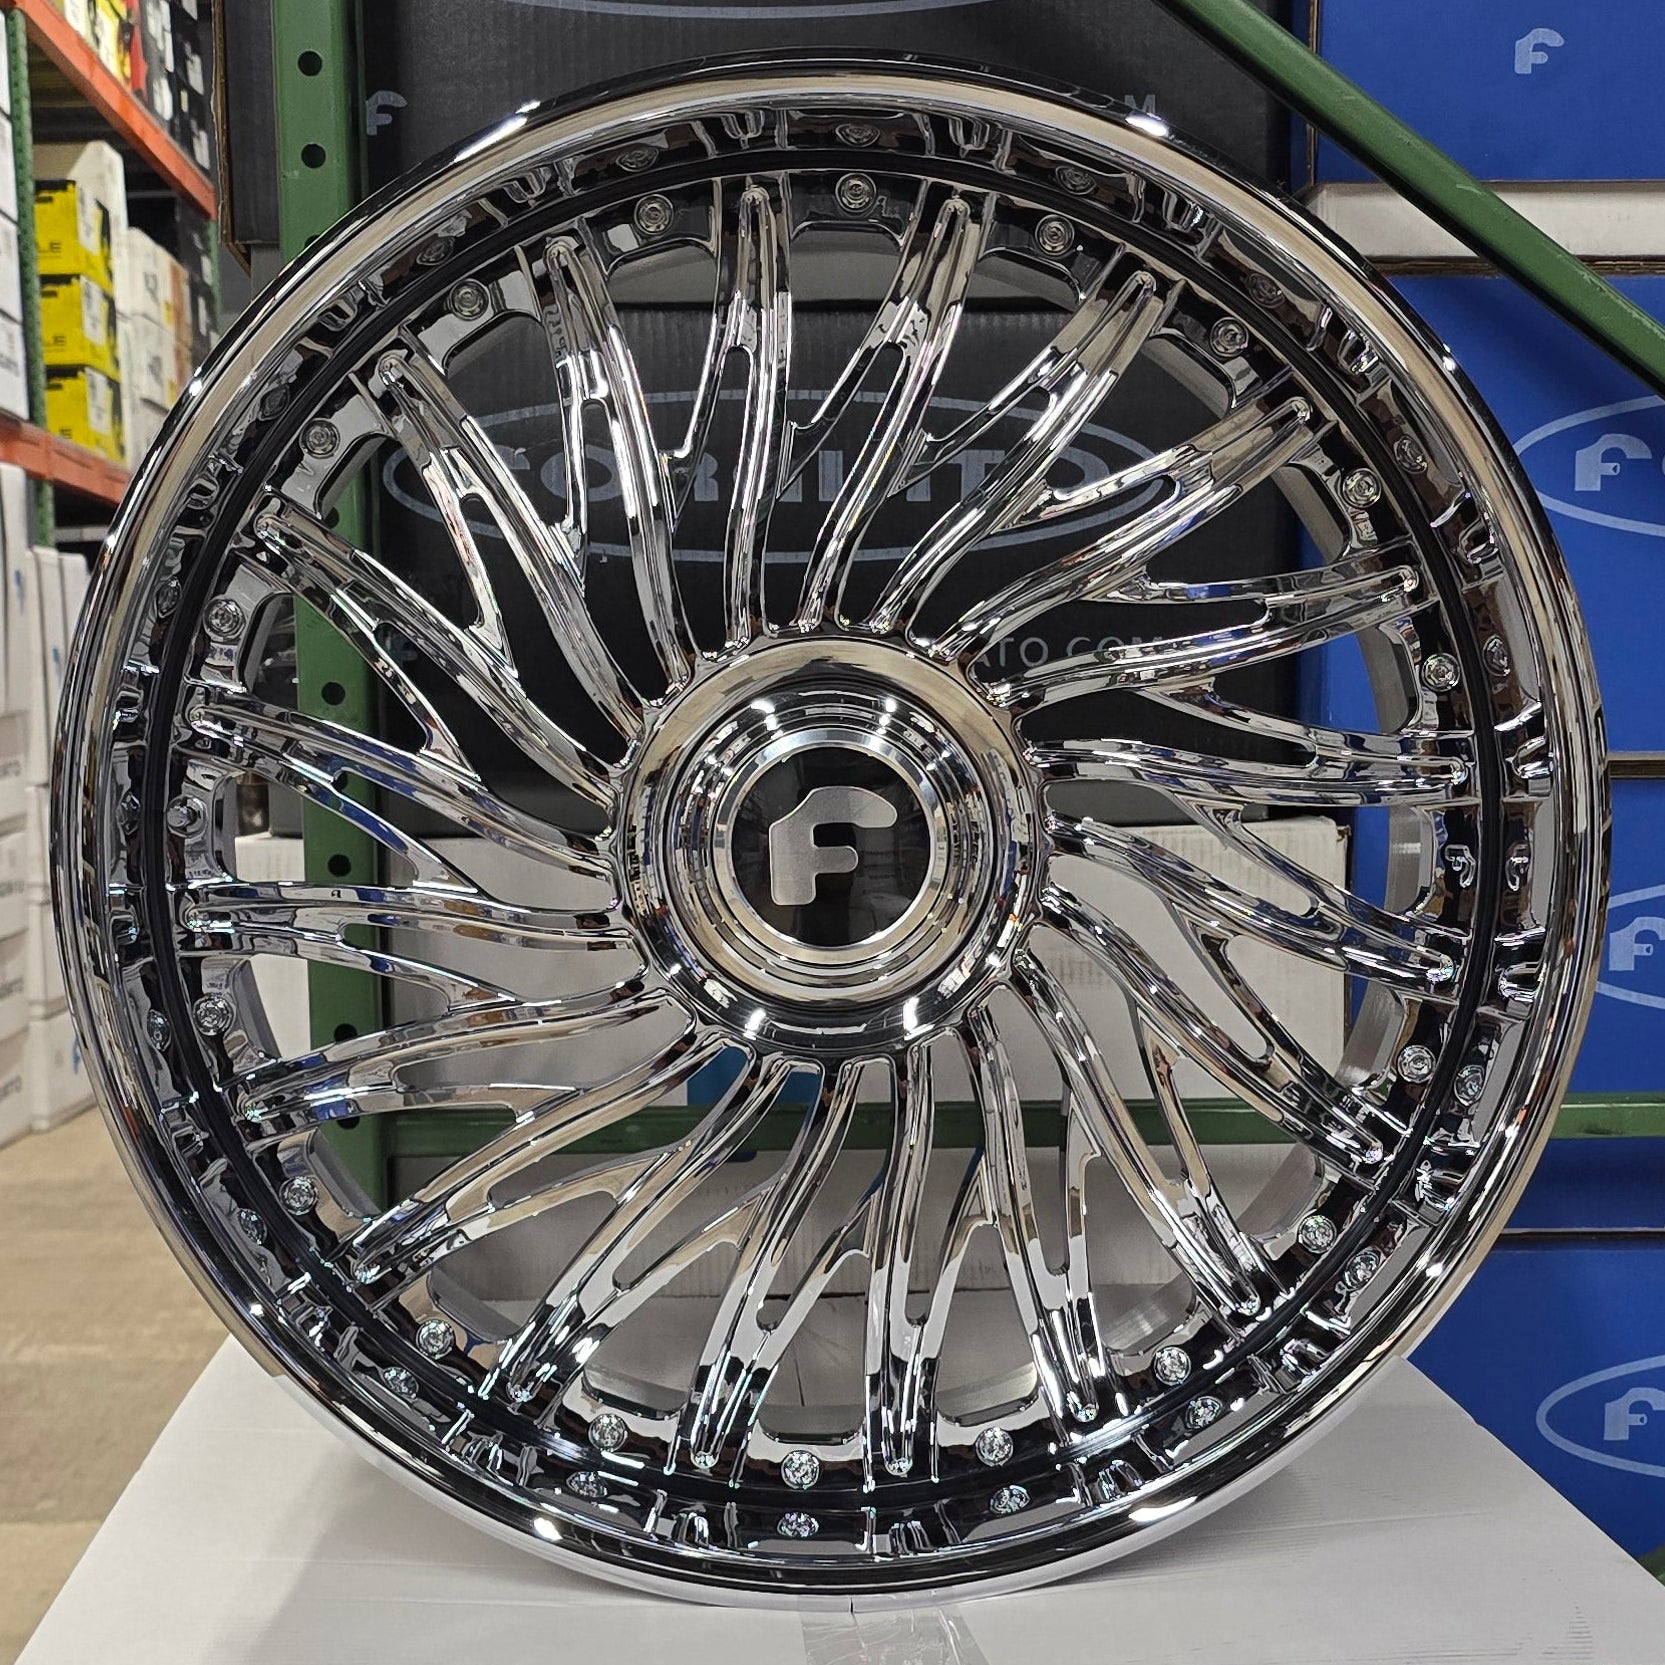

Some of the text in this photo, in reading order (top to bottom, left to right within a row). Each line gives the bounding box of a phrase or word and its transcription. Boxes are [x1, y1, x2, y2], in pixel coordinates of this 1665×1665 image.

[1514, 28, 1565, 74] F
[1574, 433, 1665, 491] F
[769, 786, 898, 906] F
